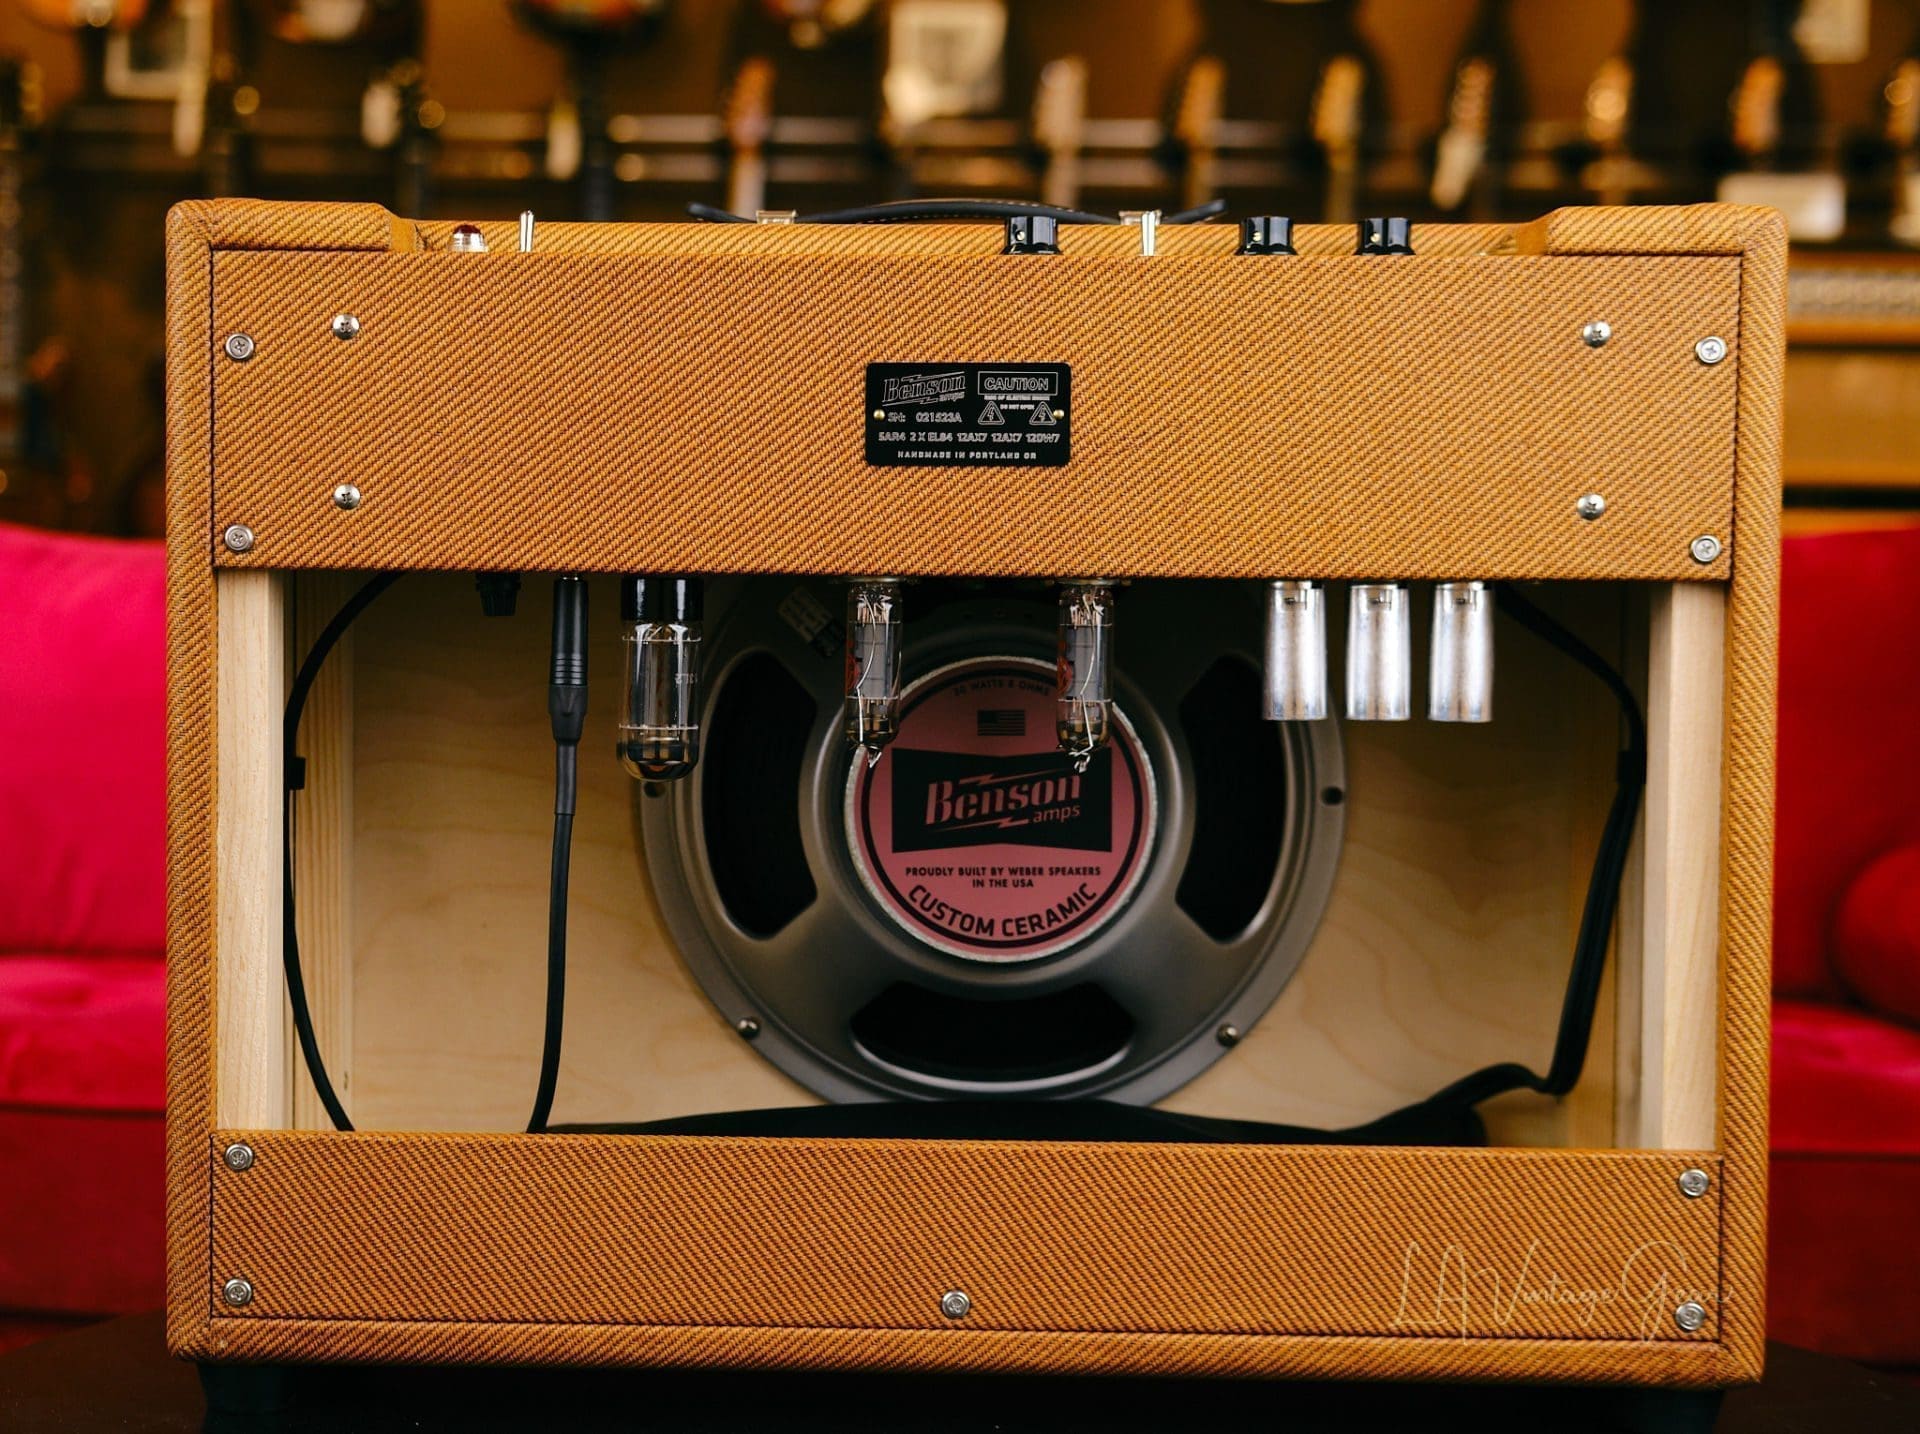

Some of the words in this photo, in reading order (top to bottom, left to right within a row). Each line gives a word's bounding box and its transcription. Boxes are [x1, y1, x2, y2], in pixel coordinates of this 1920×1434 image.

[882, 375, 966, 402] Benson
[983, 377, 1049, 391] CAUTION
[909, 432, 917, 441] 2
[957, 432, 988, 442] 12AX7
[991, 432, 1022, 442] 12AX7
[897, 450, 951, 458] HANDMADE
[969, 451, 1020, 459] PORTLAND
[925, 775, 1081, 825] Benson
[1033, 804, 1081, 823] amps
[905, 867, 954, 876] PROUDLY
[958, 867, 986, 876] BUILT
[990, 867, 1004, 876] BY
[1008, 867, 1044, 876] WEBER
[1048, 867, 1101, 876] SPEAKERS
[972, 879, 985, 888] IN
[989, 879, 1008, 888] THE
[1012, 879, 1034, 888] USA
[908, 884, 995, 937] CUSTOM
[1001, 882, 1097, 937] CERAMIC
